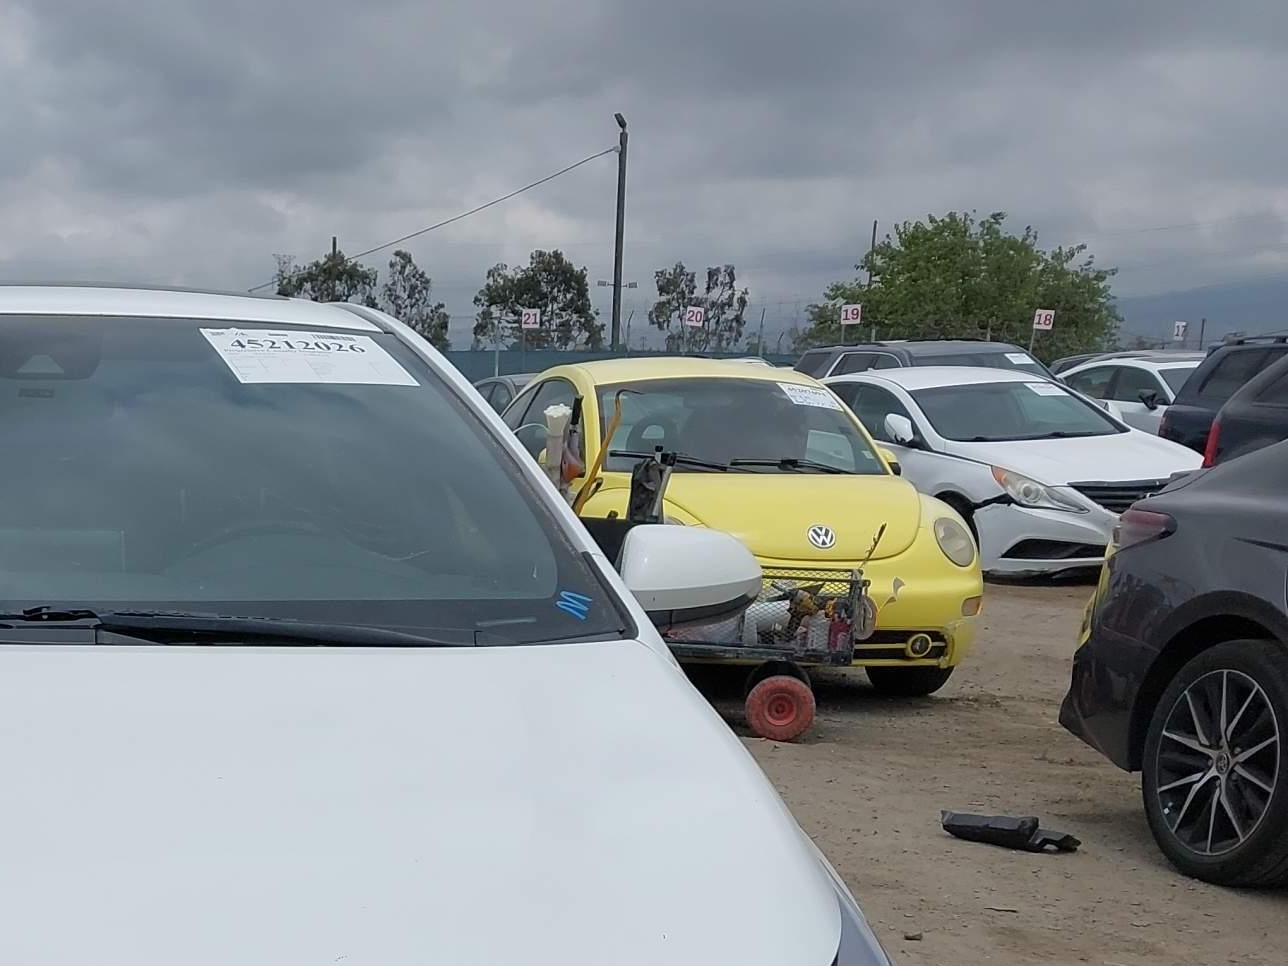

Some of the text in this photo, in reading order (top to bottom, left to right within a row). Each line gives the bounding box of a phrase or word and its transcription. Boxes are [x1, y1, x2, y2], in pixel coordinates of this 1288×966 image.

[523, 312, 538, 325] 21
[687, 309, 703, 323] 20
[842, 307, 860, 321] 19
[1035, 313, 1053, 326] 18
[1175, 324, 1188, 337] 17
[230, 338, 366, 354] 45212026
